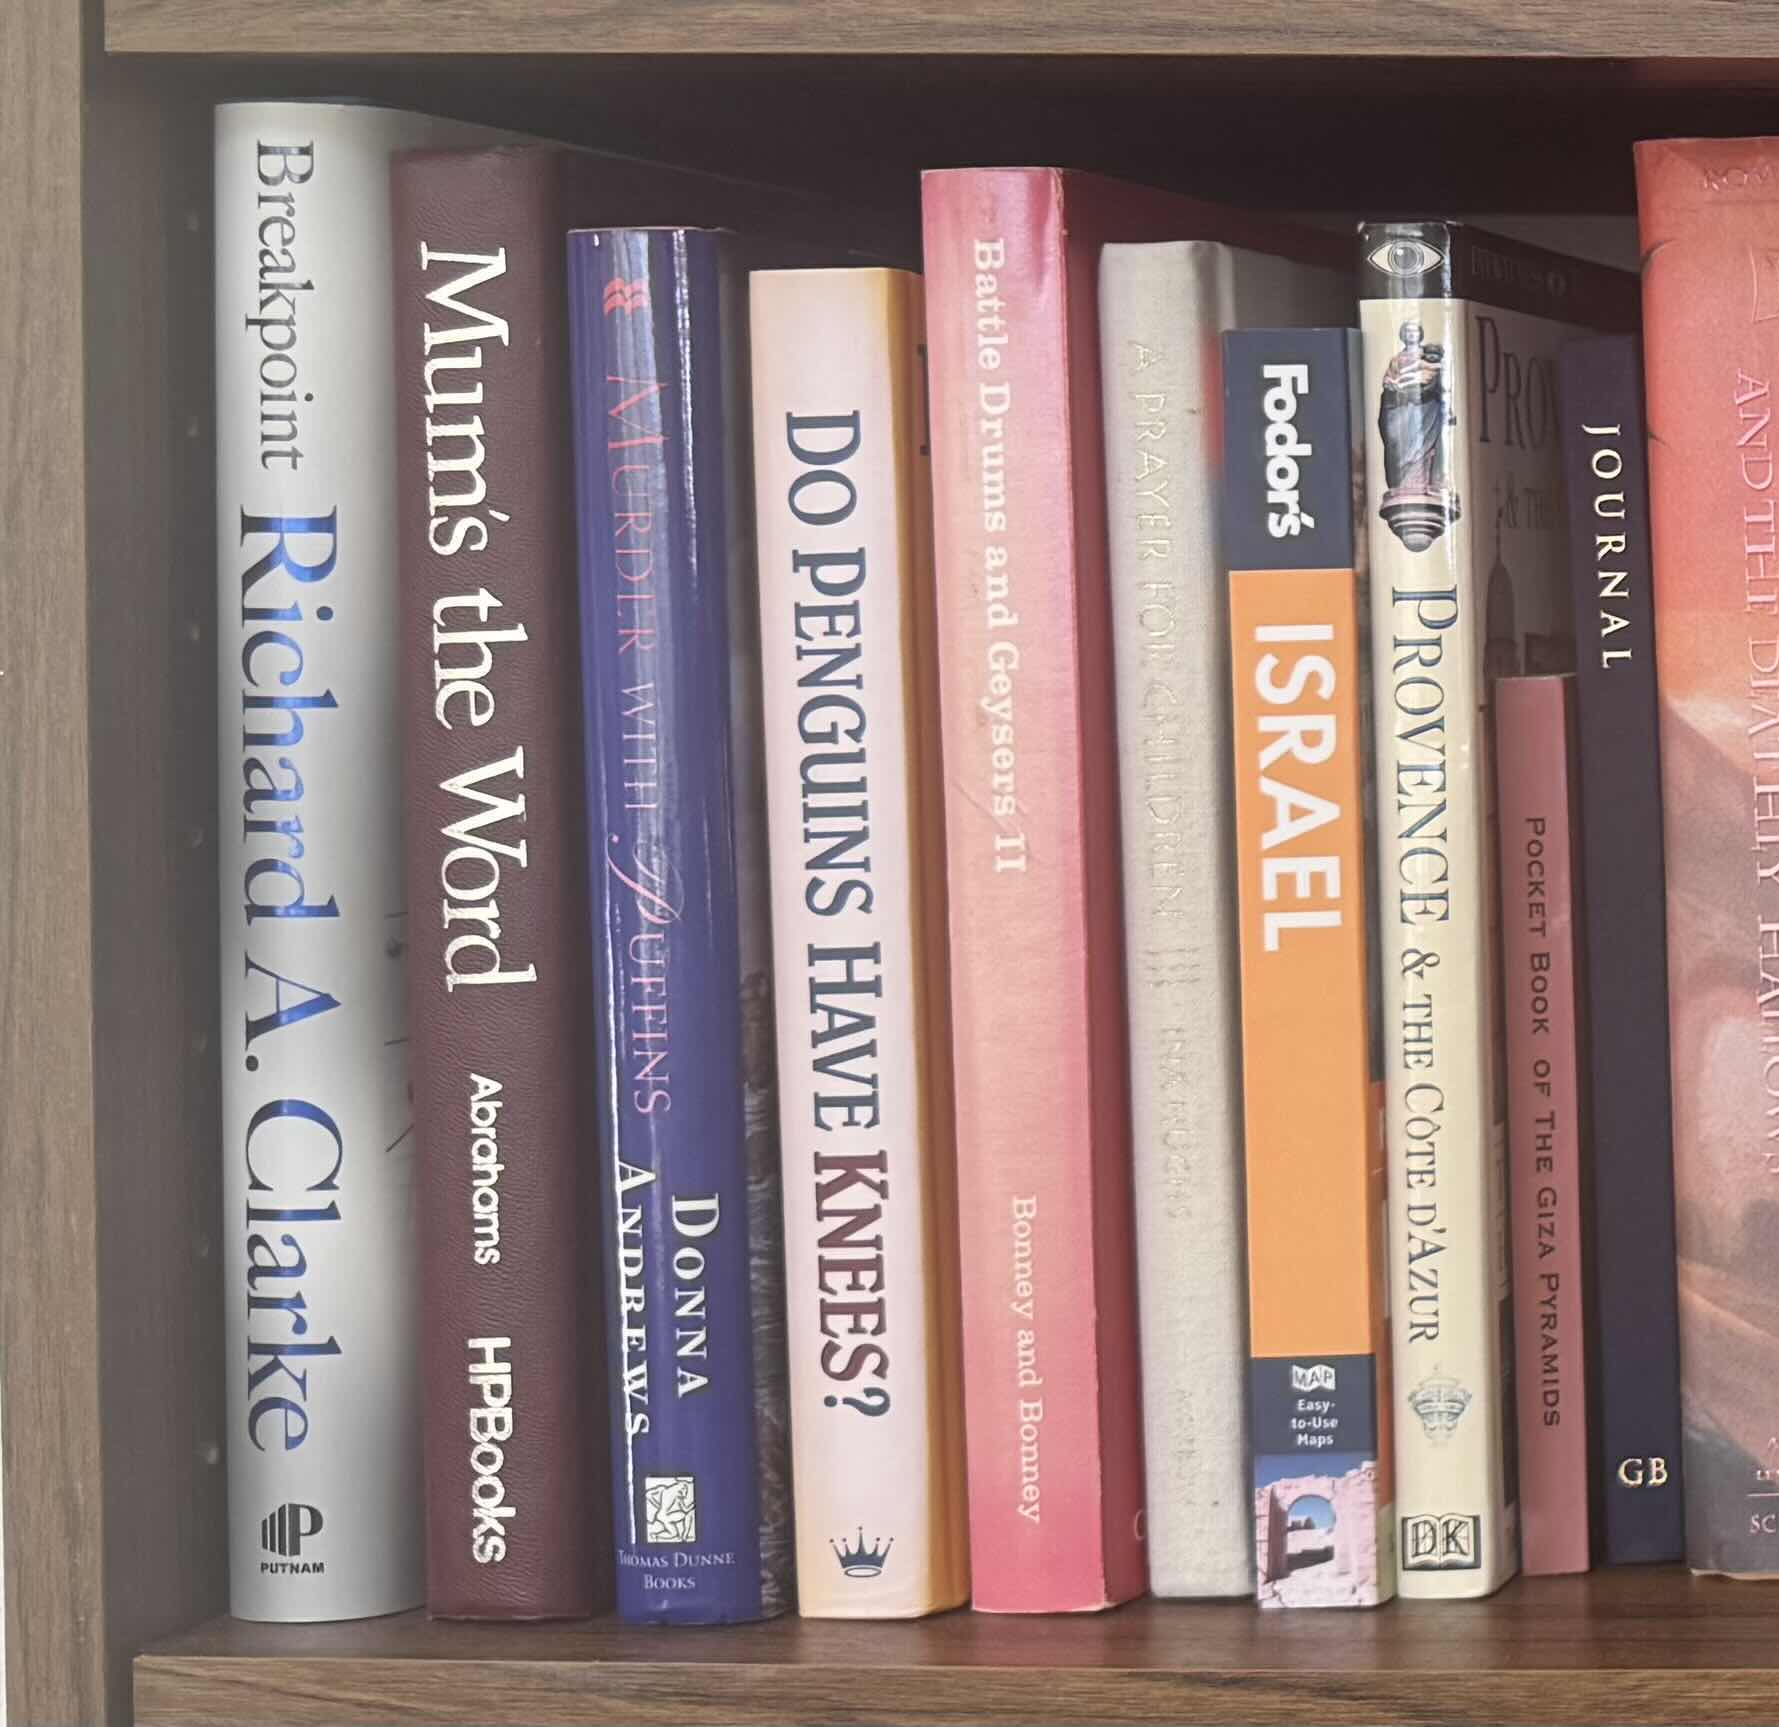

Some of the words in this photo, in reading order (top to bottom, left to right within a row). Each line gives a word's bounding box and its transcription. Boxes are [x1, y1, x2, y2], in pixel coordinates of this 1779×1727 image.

[245, 139, 315, 470] Breakpoint
[973, 239, 1009, 371] Battle
[419, 241, 513, 556] Mum's
[785, 410, 860, 527] DO
[981, 382, 1011, 532] Drums
[1261, 363, 1315, 540] Fodor's
[1734, 369, 1774, 492] AND
[983, 547, 1018, 630] and
[1582, 423, 1633, 670] JOURNAL
[239, 505, 341, 925] Richard
[432, 587, 530, 731] the
[792, 547, 874, 917] PENGUINS
[981, 640, 1020, 817] Geysers
[1253, 624, 1342, 952] ISRAEL
[1391, 585, 1458, 926] PROVENCE
[439, 745, 537, 993] Word
[993, 834, 1027, 874] II
[243, 949, 342, 1072] A.
[808, 942, 882, 1133] HAVE
[1399, 947, 1441, 981] &
[1402, 994, 1436, 1070] THE
[468, 1073, 503, 1266] Abrahams
[246, 1097, 344, 1452] Clarke
[671, 1193, 721, 1400] DONNA
[814, 1150, 890, 1418] KNEES?
[1011, 1195, 1037, 1321] Bonney
[1017, 1328, 1043, 1388] and
[1290, 1417, 1338, 1430] to-Use
[467, 1337, 514, 1565] HPBooks
[1019, 1400, 1045, 1524] Bonney
[1296, 1433, 1334, 1448] Maps
[260, 1562, 325, 1575] PUTNAM
[1411, 1517, 1475, 1559] DK
